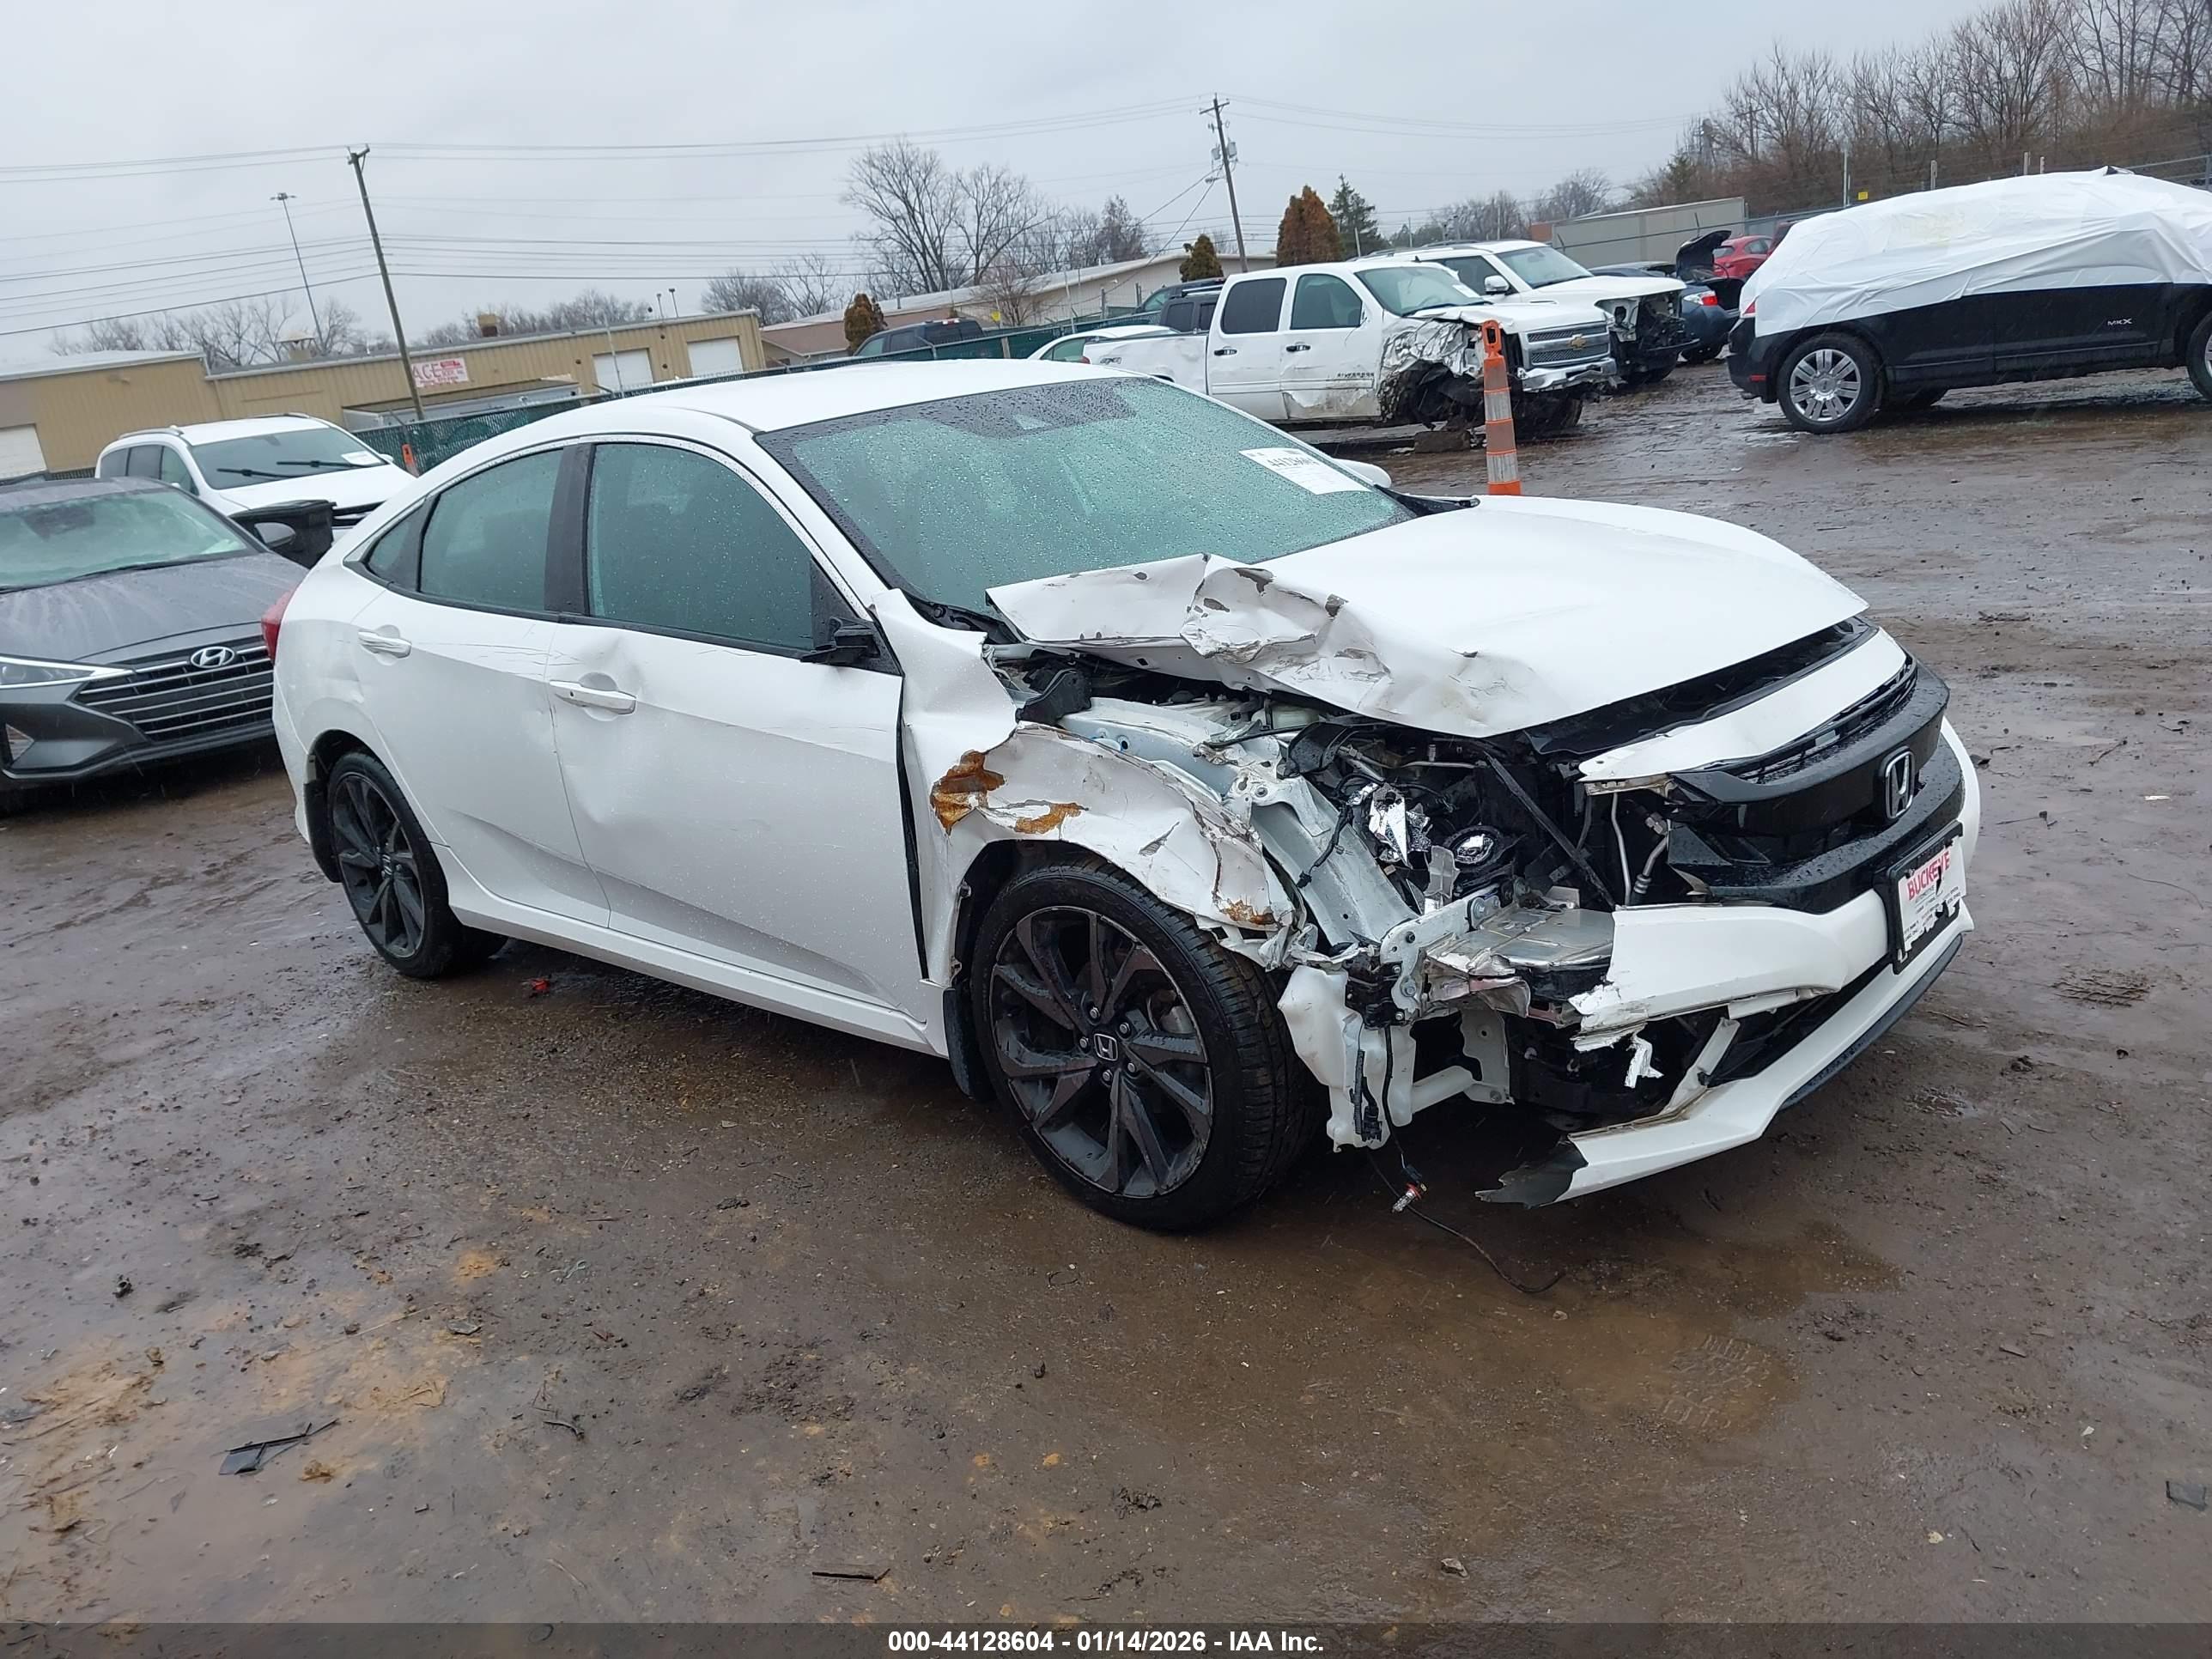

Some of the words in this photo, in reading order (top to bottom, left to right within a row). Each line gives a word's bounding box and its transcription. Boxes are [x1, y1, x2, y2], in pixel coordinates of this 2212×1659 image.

[2107, 318, 2133, 326] MKX
[411, 362, 441, 380] ACE
[1906, 850, 1951, 900] BUCKEYE
